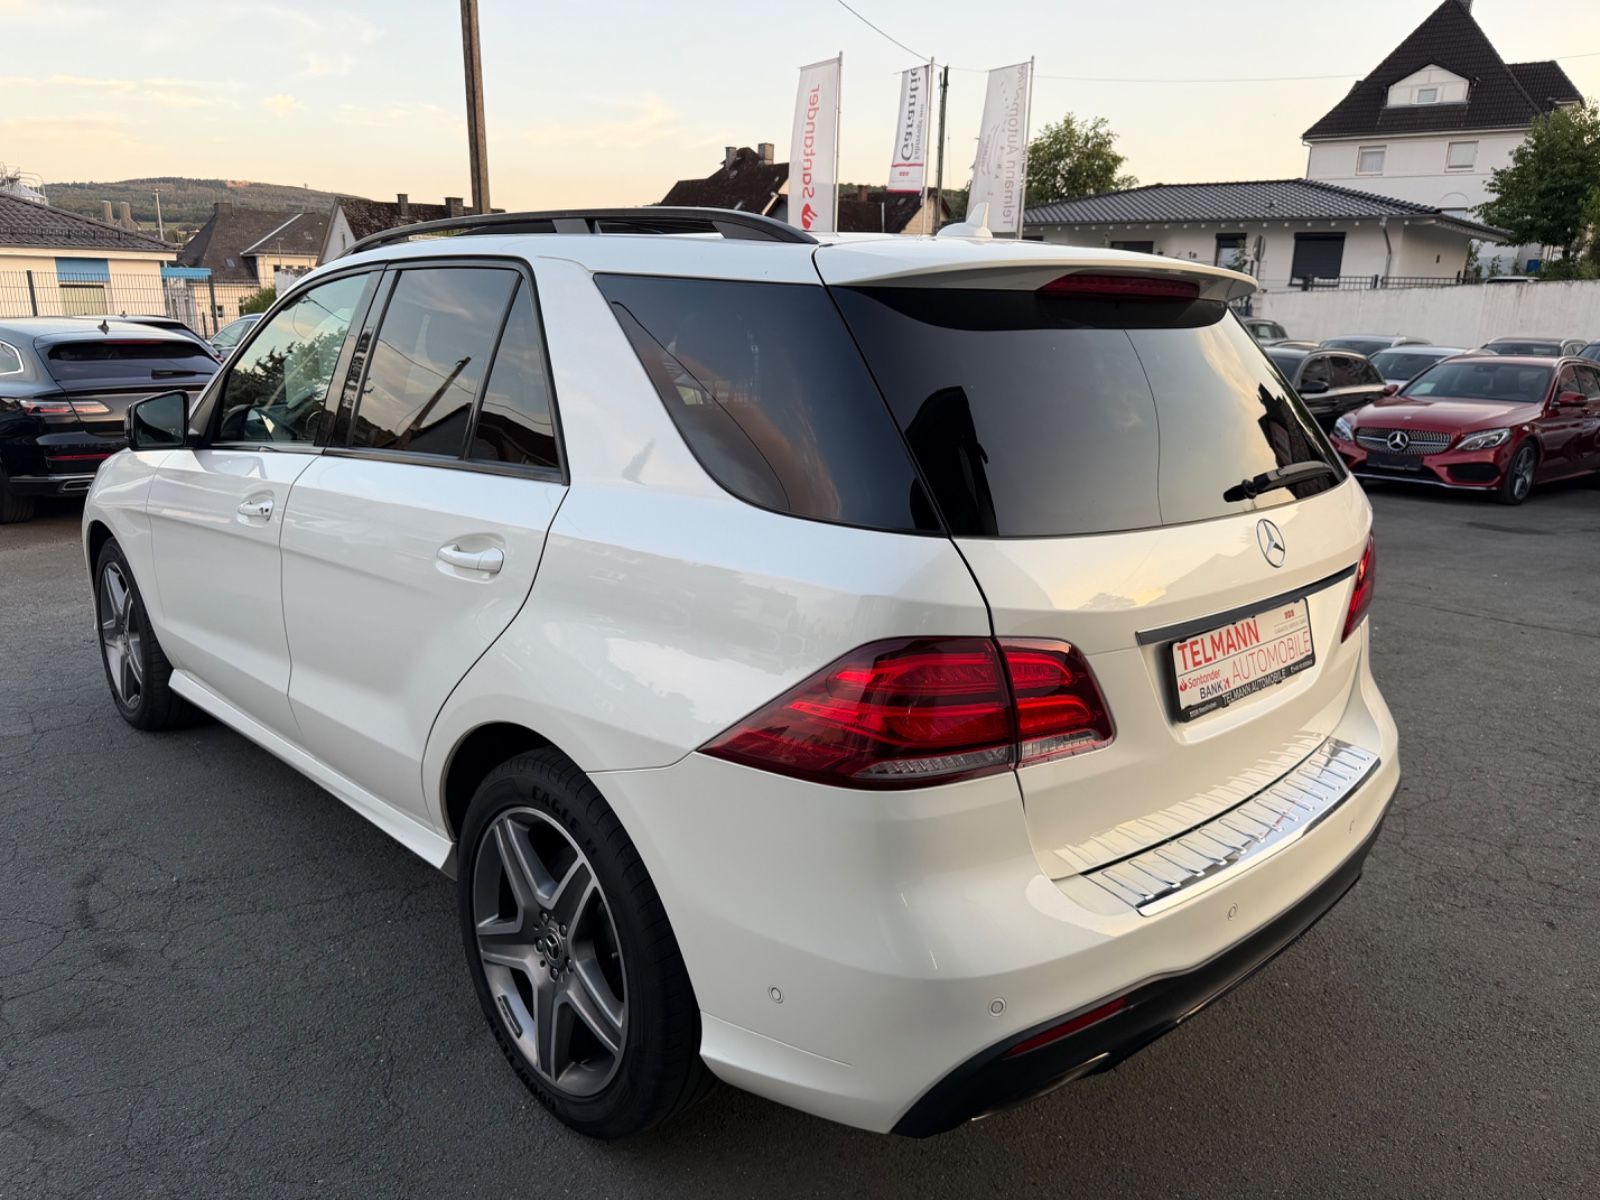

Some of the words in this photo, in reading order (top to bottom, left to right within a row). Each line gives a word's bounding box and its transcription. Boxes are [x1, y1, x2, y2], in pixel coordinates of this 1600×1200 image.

[1177, 618, 1261, 671] TELMANN
[1232, 630, 1312, 684] AUTOMOBILE
[1188, 668, 1221, 690] Santander
[1221, 683, 1252, 706] TELMANN
